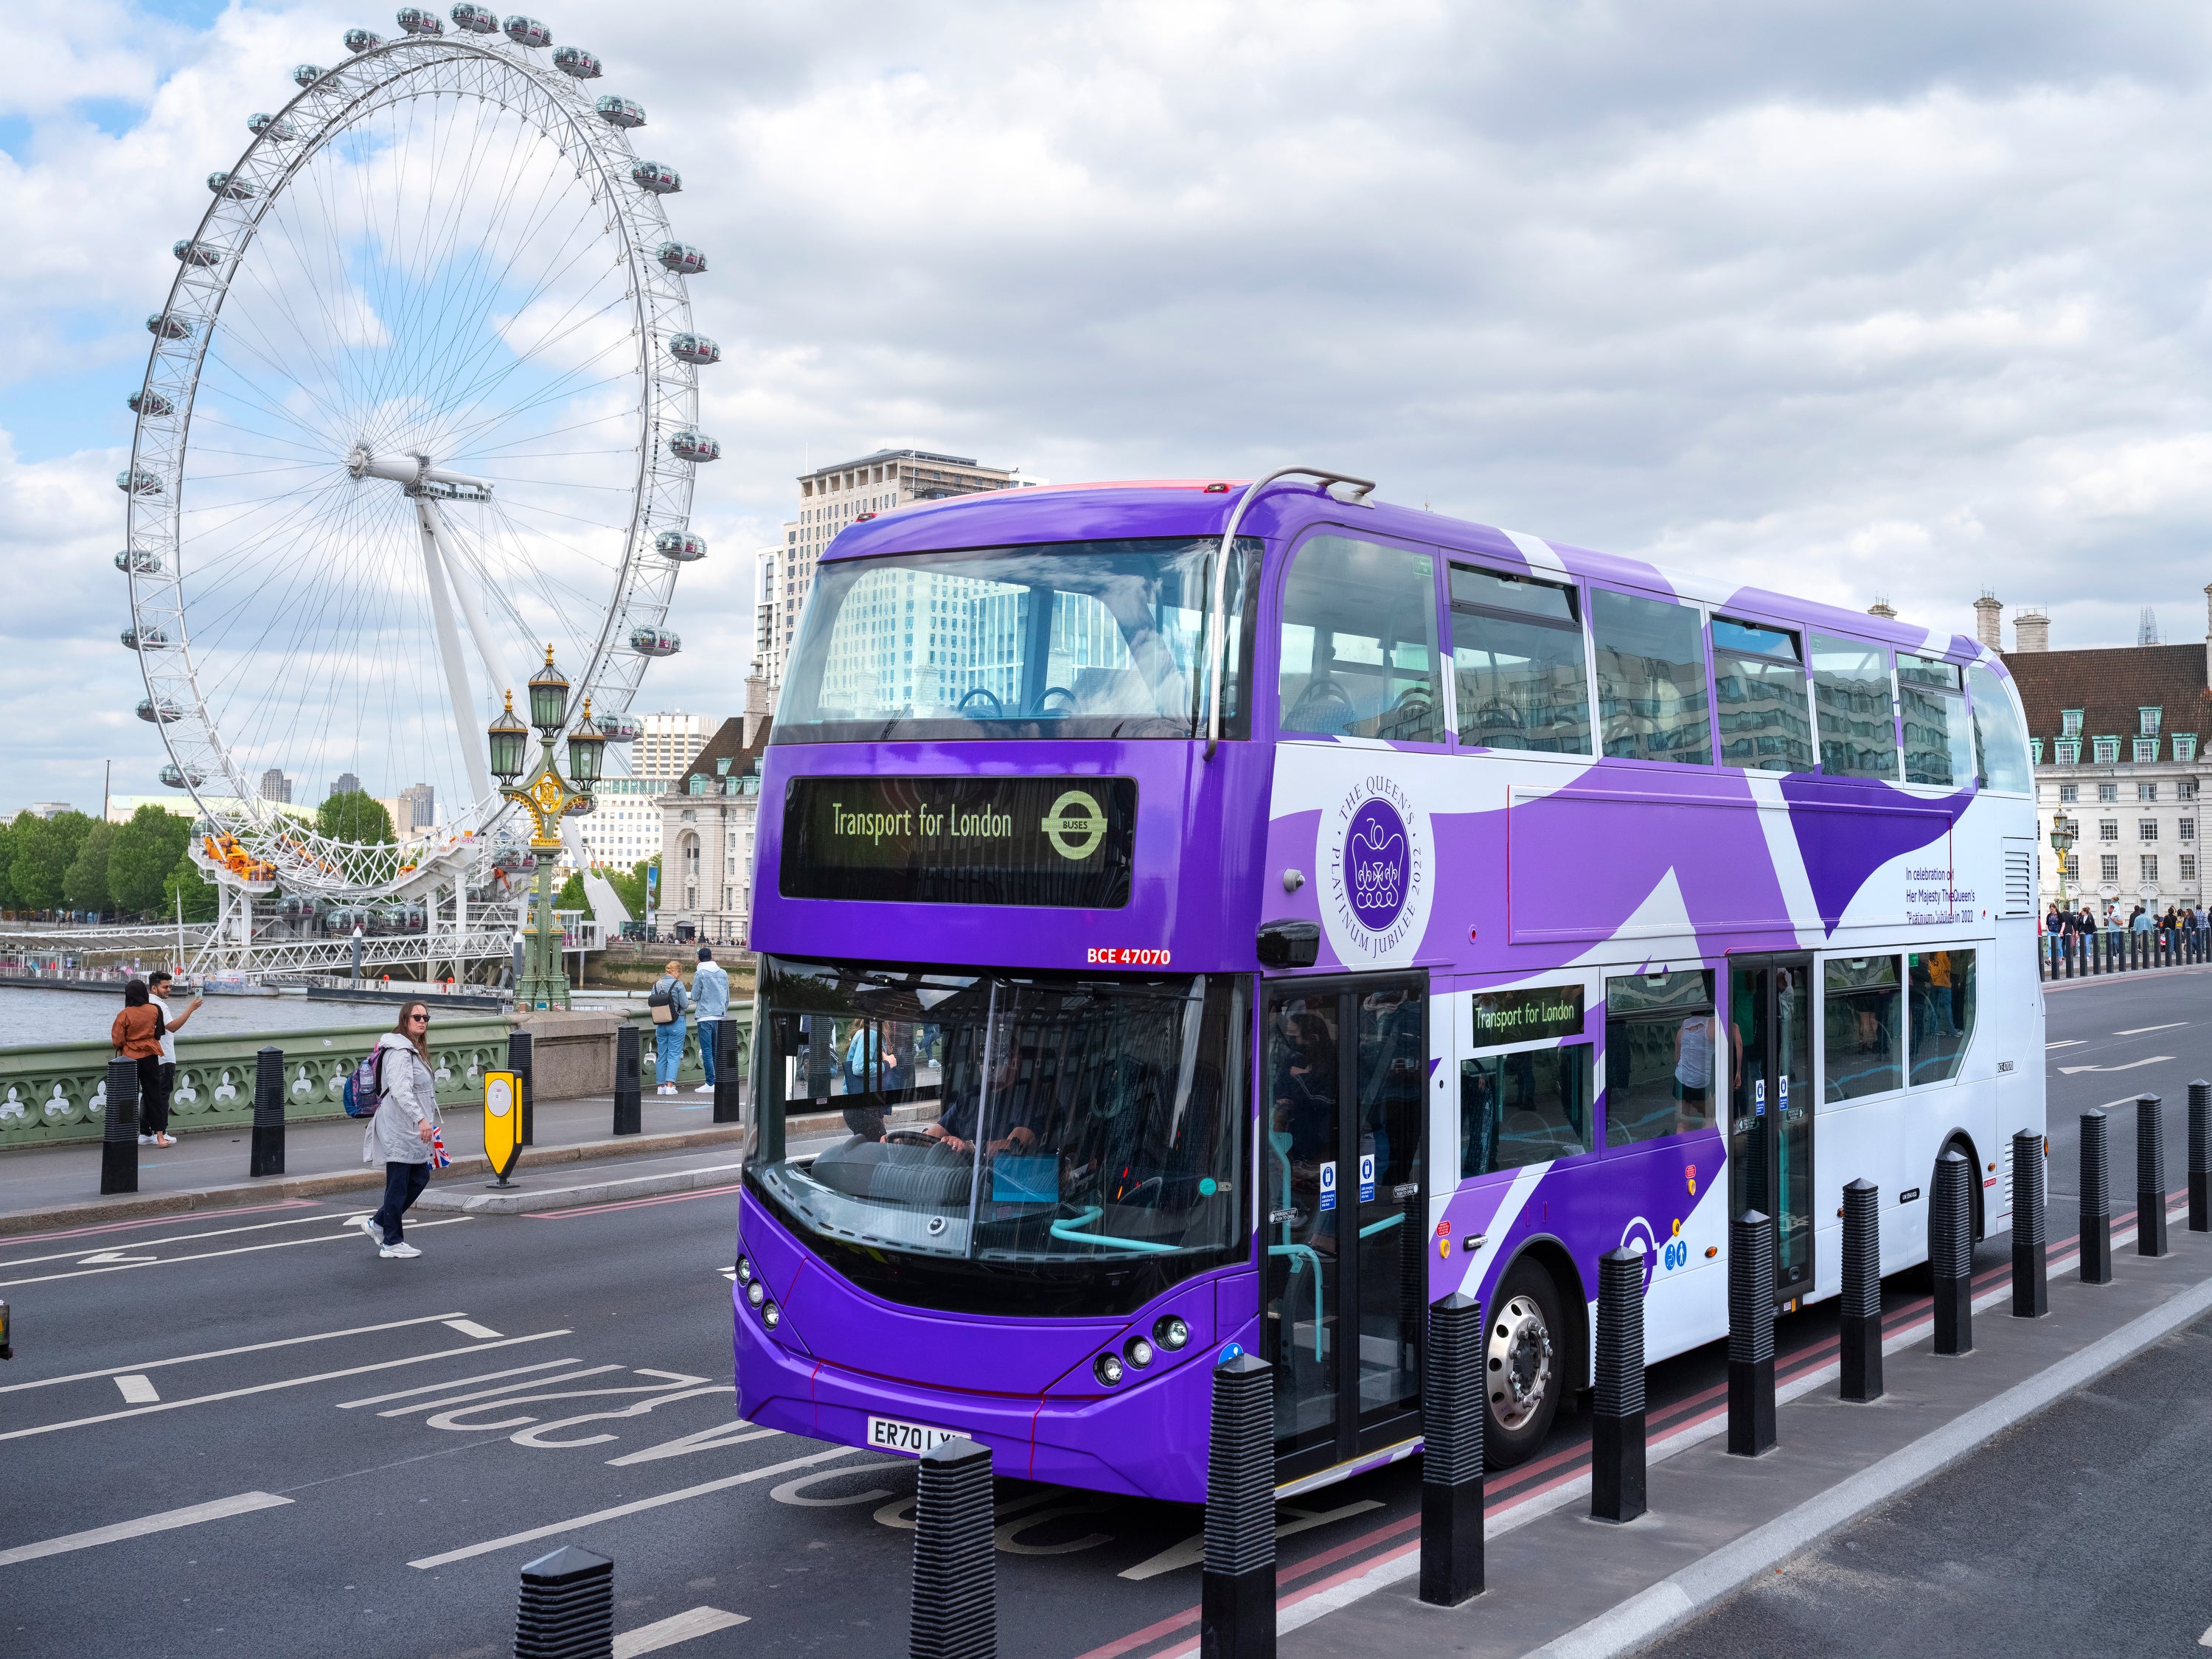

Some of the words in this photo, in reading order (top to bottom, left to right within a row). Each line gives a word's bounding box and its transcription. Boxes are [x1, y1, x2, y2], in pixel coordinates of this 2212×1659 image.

[1339, 784, 1363, 821] THE
[1366, 775, 1415, 826] QUEEN'S
[832, 803, 911, 846] Transport
[919, 804, 945, 837] for
[951, 804, 1012, 838] London
[1062, 820, 1088, 830] BUSES
[1906, 867, 1912, 880] In
[1913, 867, 1946, 880] celebration
[1947, 869, 1955, 880] of
[1331, 846, 1369, 952] PLATINUM
[1373, 901, 1416, 959] JUBILEE
[1411, 846, 1422, 896] 2022
[1906, 889, 1917, 902] Her
[1919, 889, 1941, 905] Majesty
[1941, 889, 1954, 902] The
[1954, 889, 1975, 902] Queen's
[1907, 911, 1935, 925] Platinum
[1955, 911, 1961, 922] in
[1961, 910, 1973, 923] 2022
[1088, 948, 1117, 963] BCE
[1121, 949, 1171, 964] 47070
[1475, 1006, 1522, 1032] Transport
[1526, 1003, 1539, 1023] for
[1542, 1000, 1574, 1022] London
[874, 1421, 922, 1450] ER70
